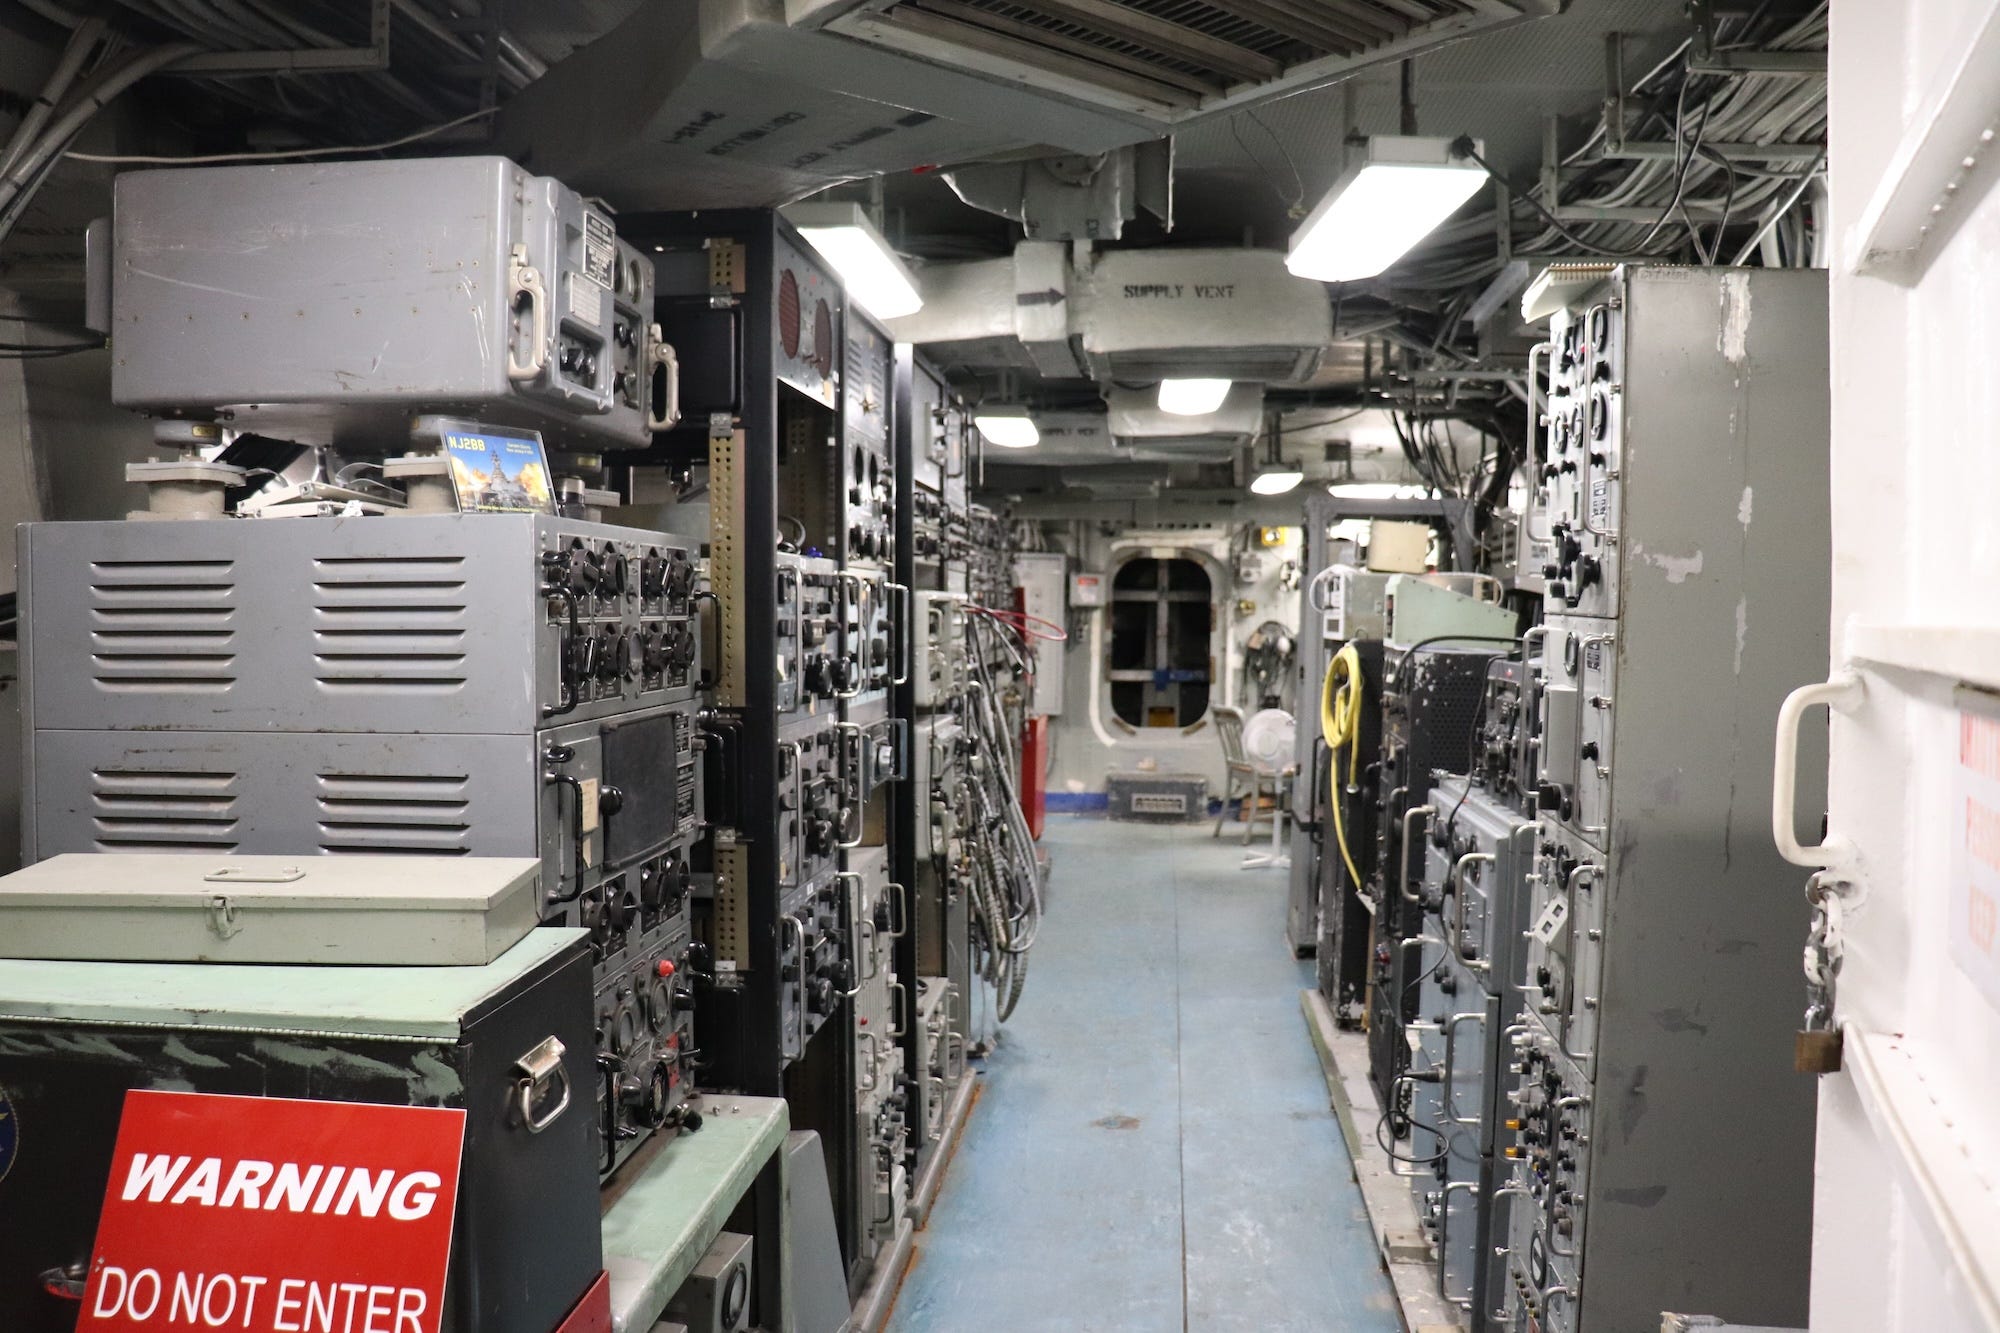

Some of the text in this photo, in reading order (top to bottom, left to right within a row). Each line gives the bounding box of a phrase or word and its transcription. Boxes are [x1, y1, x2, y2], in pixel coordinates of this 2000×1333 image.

[1124, 285, 1234, 299] SUPPLY VENT
[121, 1153, 442, 1221] WARNING
[93, 1266, 428, 1333] DO NOT ENTER
